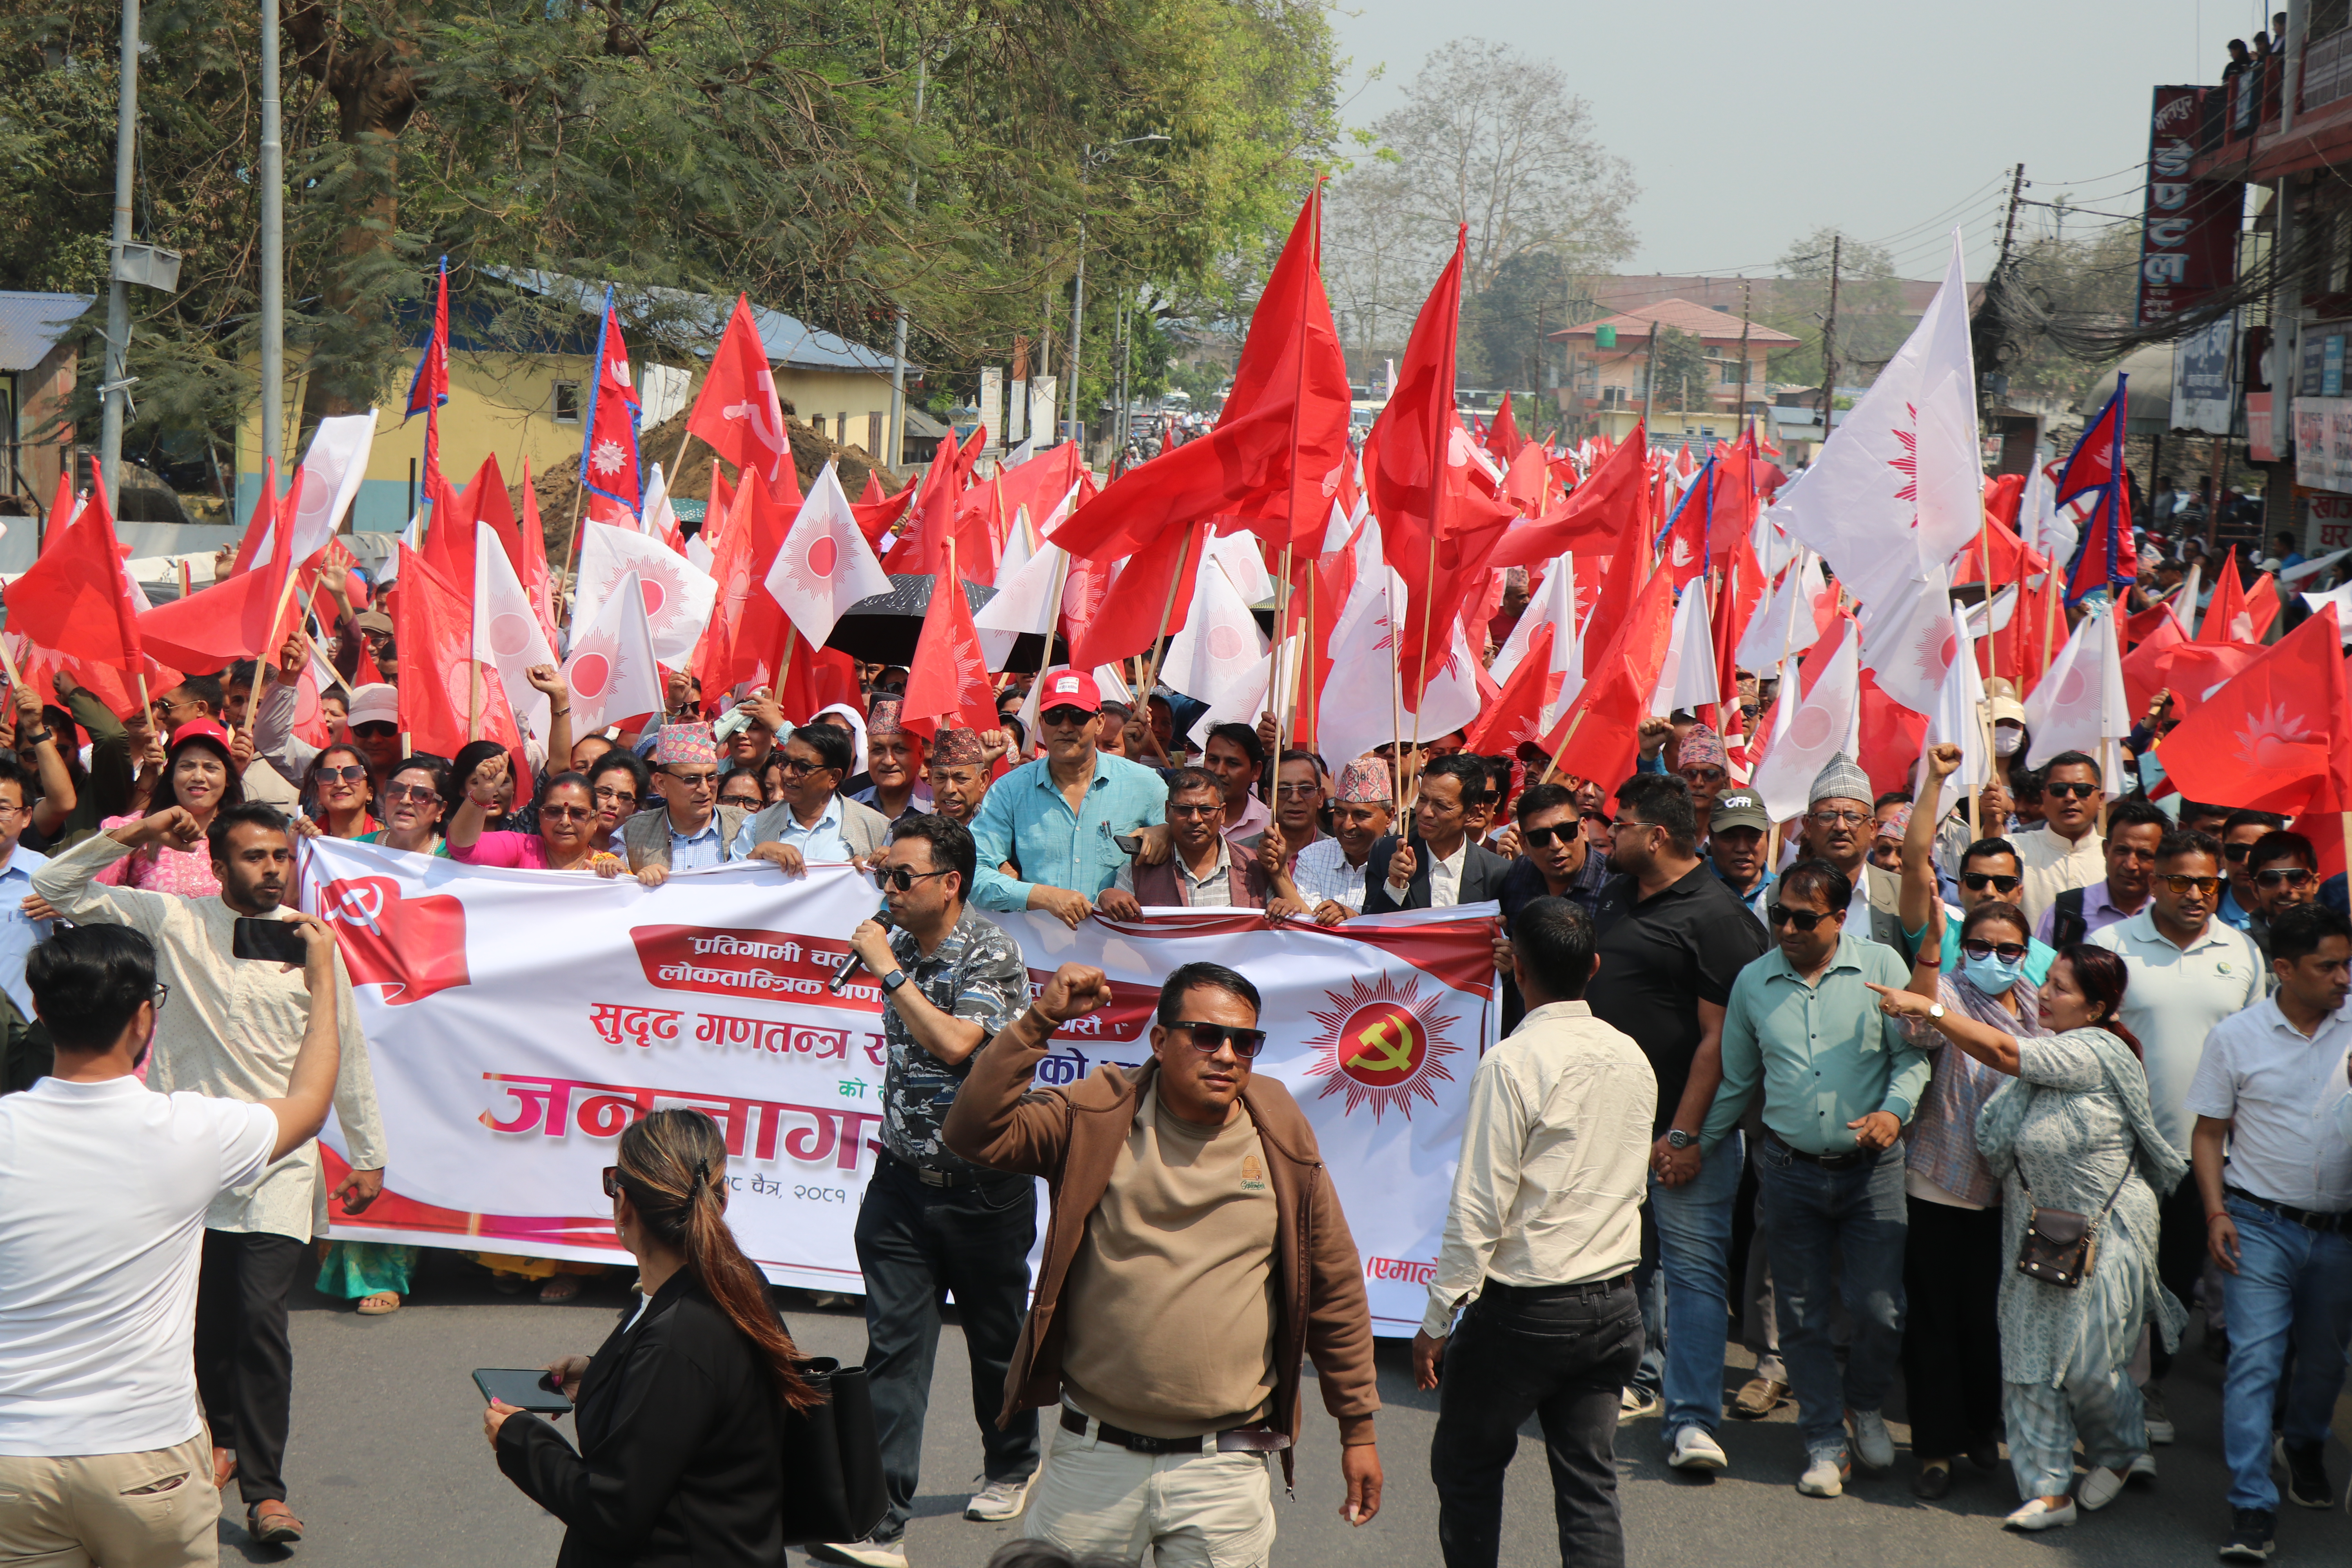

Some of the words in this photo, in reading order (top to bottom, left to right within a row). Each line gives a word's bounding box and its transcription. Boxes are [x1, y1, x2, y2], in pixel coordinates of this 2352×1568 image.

[2154, 95, 2193, 131] भरतपुर
[2320, 524, 2352, 548] घर
[659, 962, 825, 995] लोकतान्त्रिक
[590, 1003, 685, 1048] सुदृढ
[696, 1013, 852, 1060] गणतन्त्र
[838, 1077, 867, 1099] को
[751, 1172, 782, 1199] चैत्र,
[794, 1185, 846, 1203] २०८१
[1240, 1180, 1265, 1191] September
